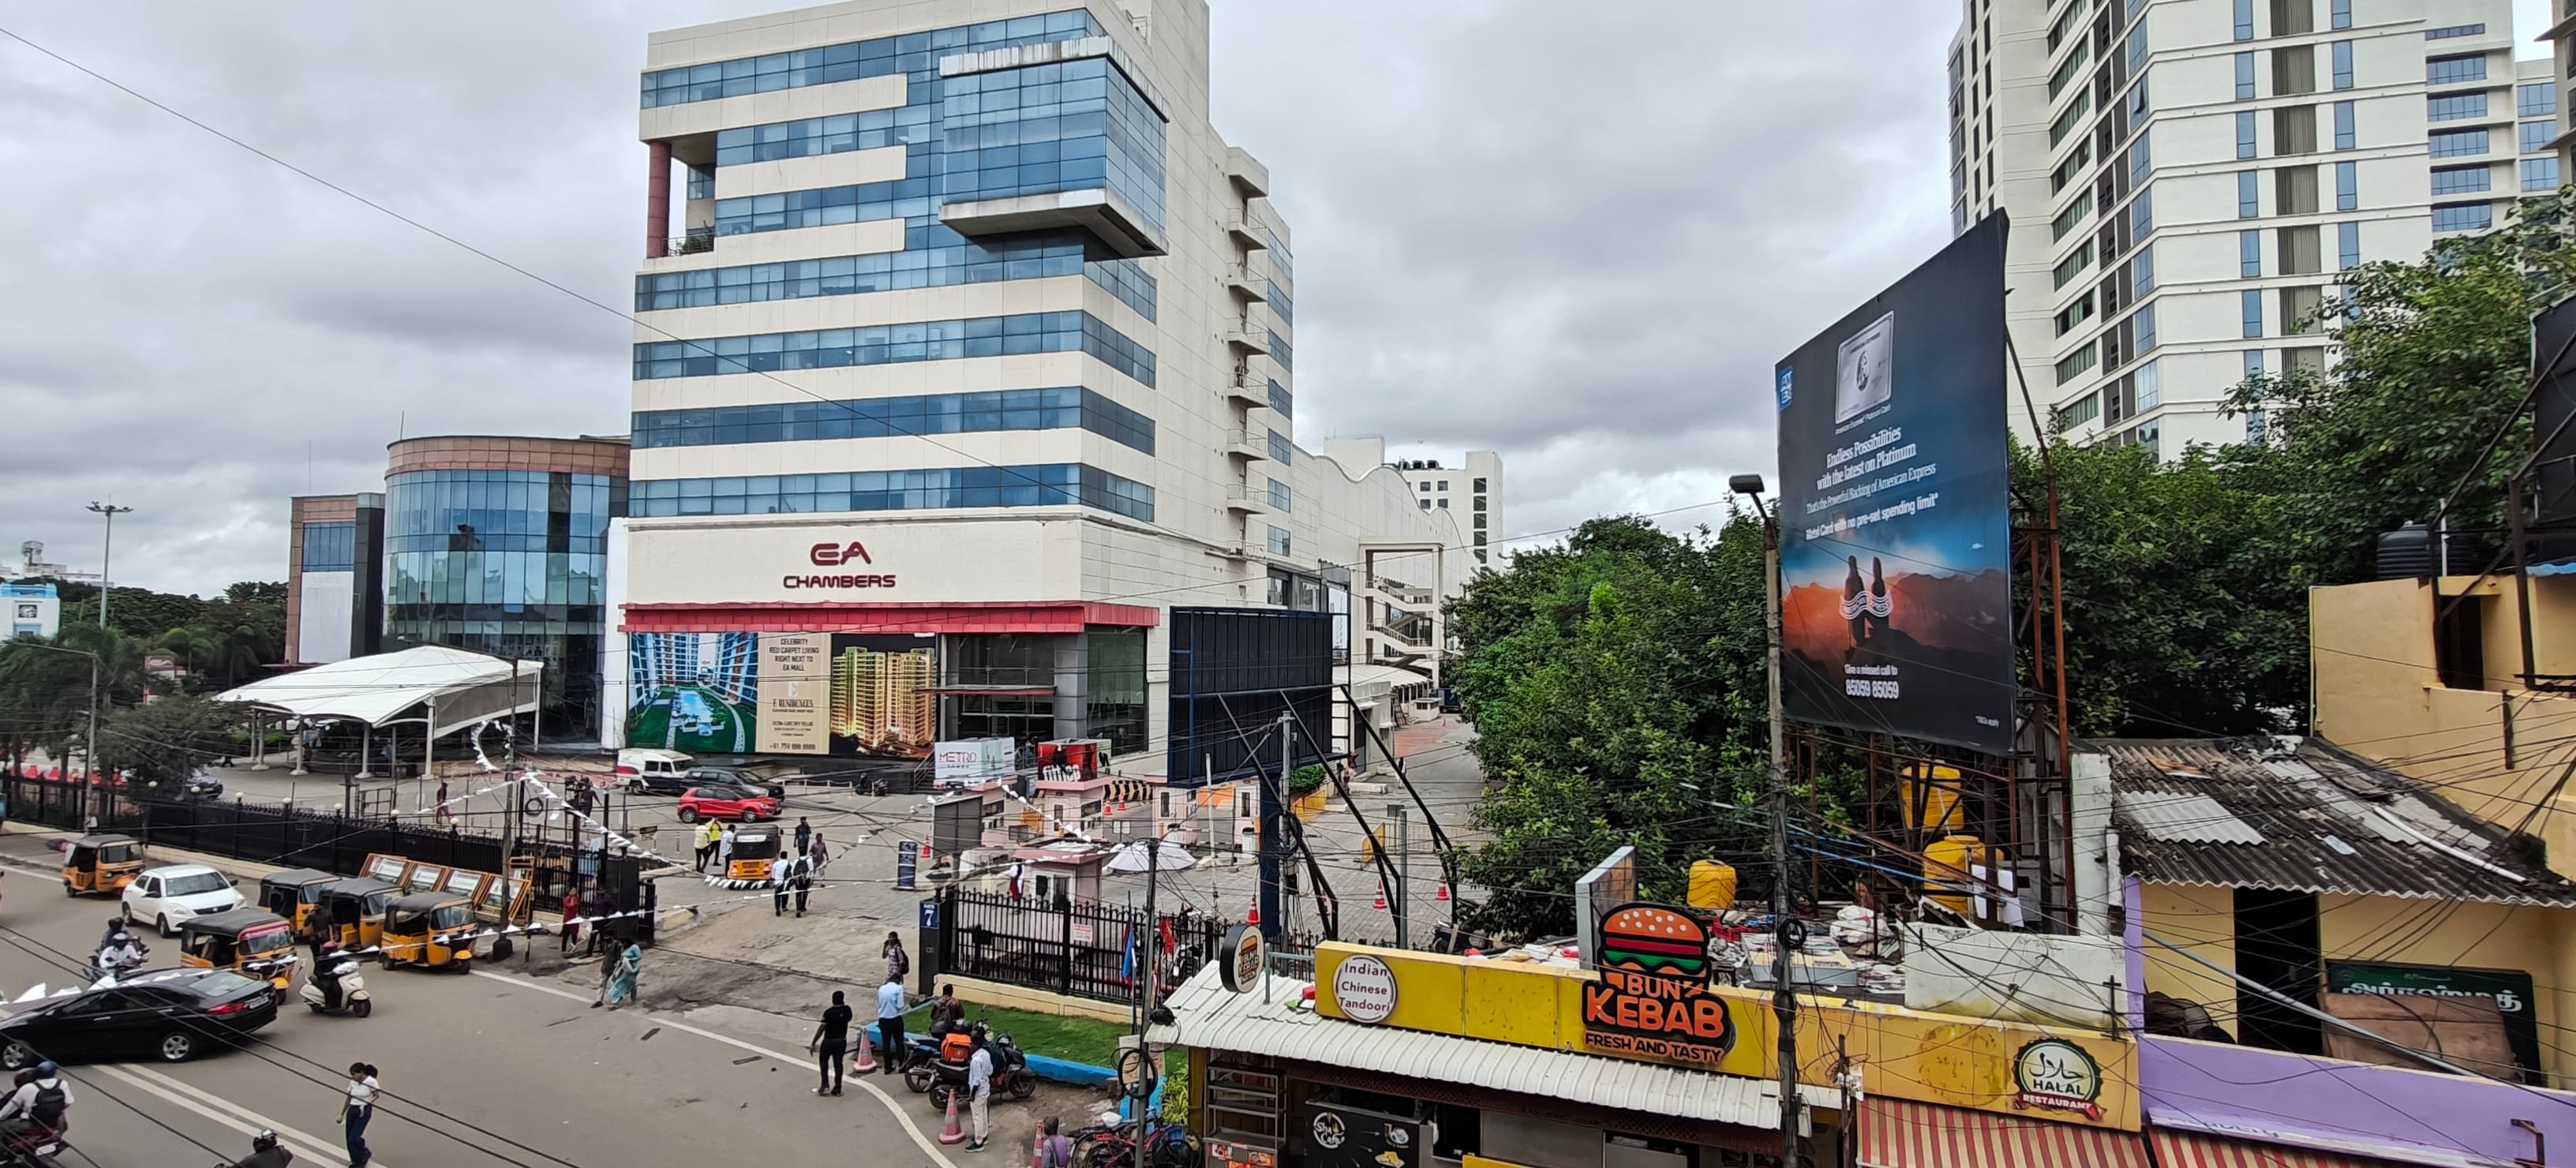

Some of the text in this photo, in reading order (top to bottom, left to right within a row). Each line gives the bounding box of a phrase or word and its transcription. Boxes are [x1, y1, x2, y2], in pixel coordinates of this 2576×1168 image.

[1826, 426, 1901, 469] Endless Possibilities
[1817, 443, 1917, 491] with the latest on Platinum
[1871, 478, 1878, 493] of
[1878, 472, 1908, 490] American
[1908, 463, 1937, 482] Express
[1820, 521, 1833, 537] Card
[1833, 517, 1847, 533] with
[1847, 517, 1856, 529] no
[1856, 507, 1881, 529] pre-set
[1881, 500, 1915, 522] spending
[811, 541, 871, 566] EA
[783, 575, 897, 589] CHAMBERS
[1881, 664, 1891, 676] call
[1891, 664, 1898, 676] to
[1845, 679, 1899, 699] 85059 85059
[939, 751, 977, 763] METRO
[923, 909, 934, 927] 7
[1344, 962, 1387, 977] Indian
[1341, 981, 1387, 995] Chinese
[1627, 974, 1681, 1001] BUN
[1339, 996, 1390, 1013] Tandoori
[1587, 986, 1724, 1039] KEBAB
[1585, 1032, 1724, 1063] FRESH AND TASTY
[2028, 1052, 2084, 1080] حلال
[2033, 1079, 2085, 1096] HALAL
[2023, 1094, 2092, 1109] RESTAURANT
